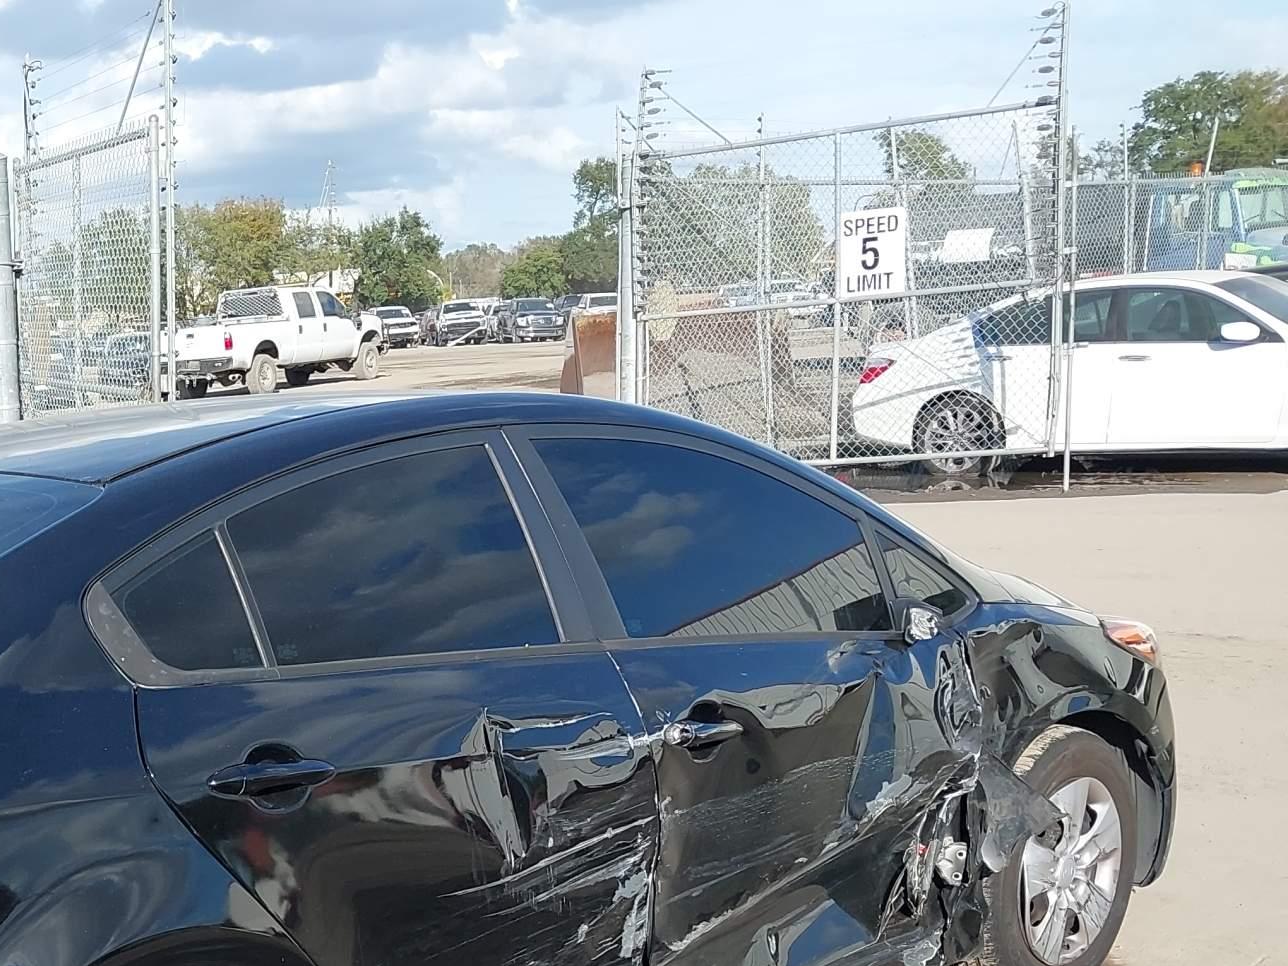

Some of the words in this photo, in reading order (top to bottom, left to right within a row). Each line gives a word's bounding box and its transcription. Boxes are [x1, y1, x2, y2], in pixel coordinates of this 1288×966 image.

[843, 215, 899, 237] SPEED
[861, 236, 880, 270] 5
[847, 272, 894, 293] LIMIT
